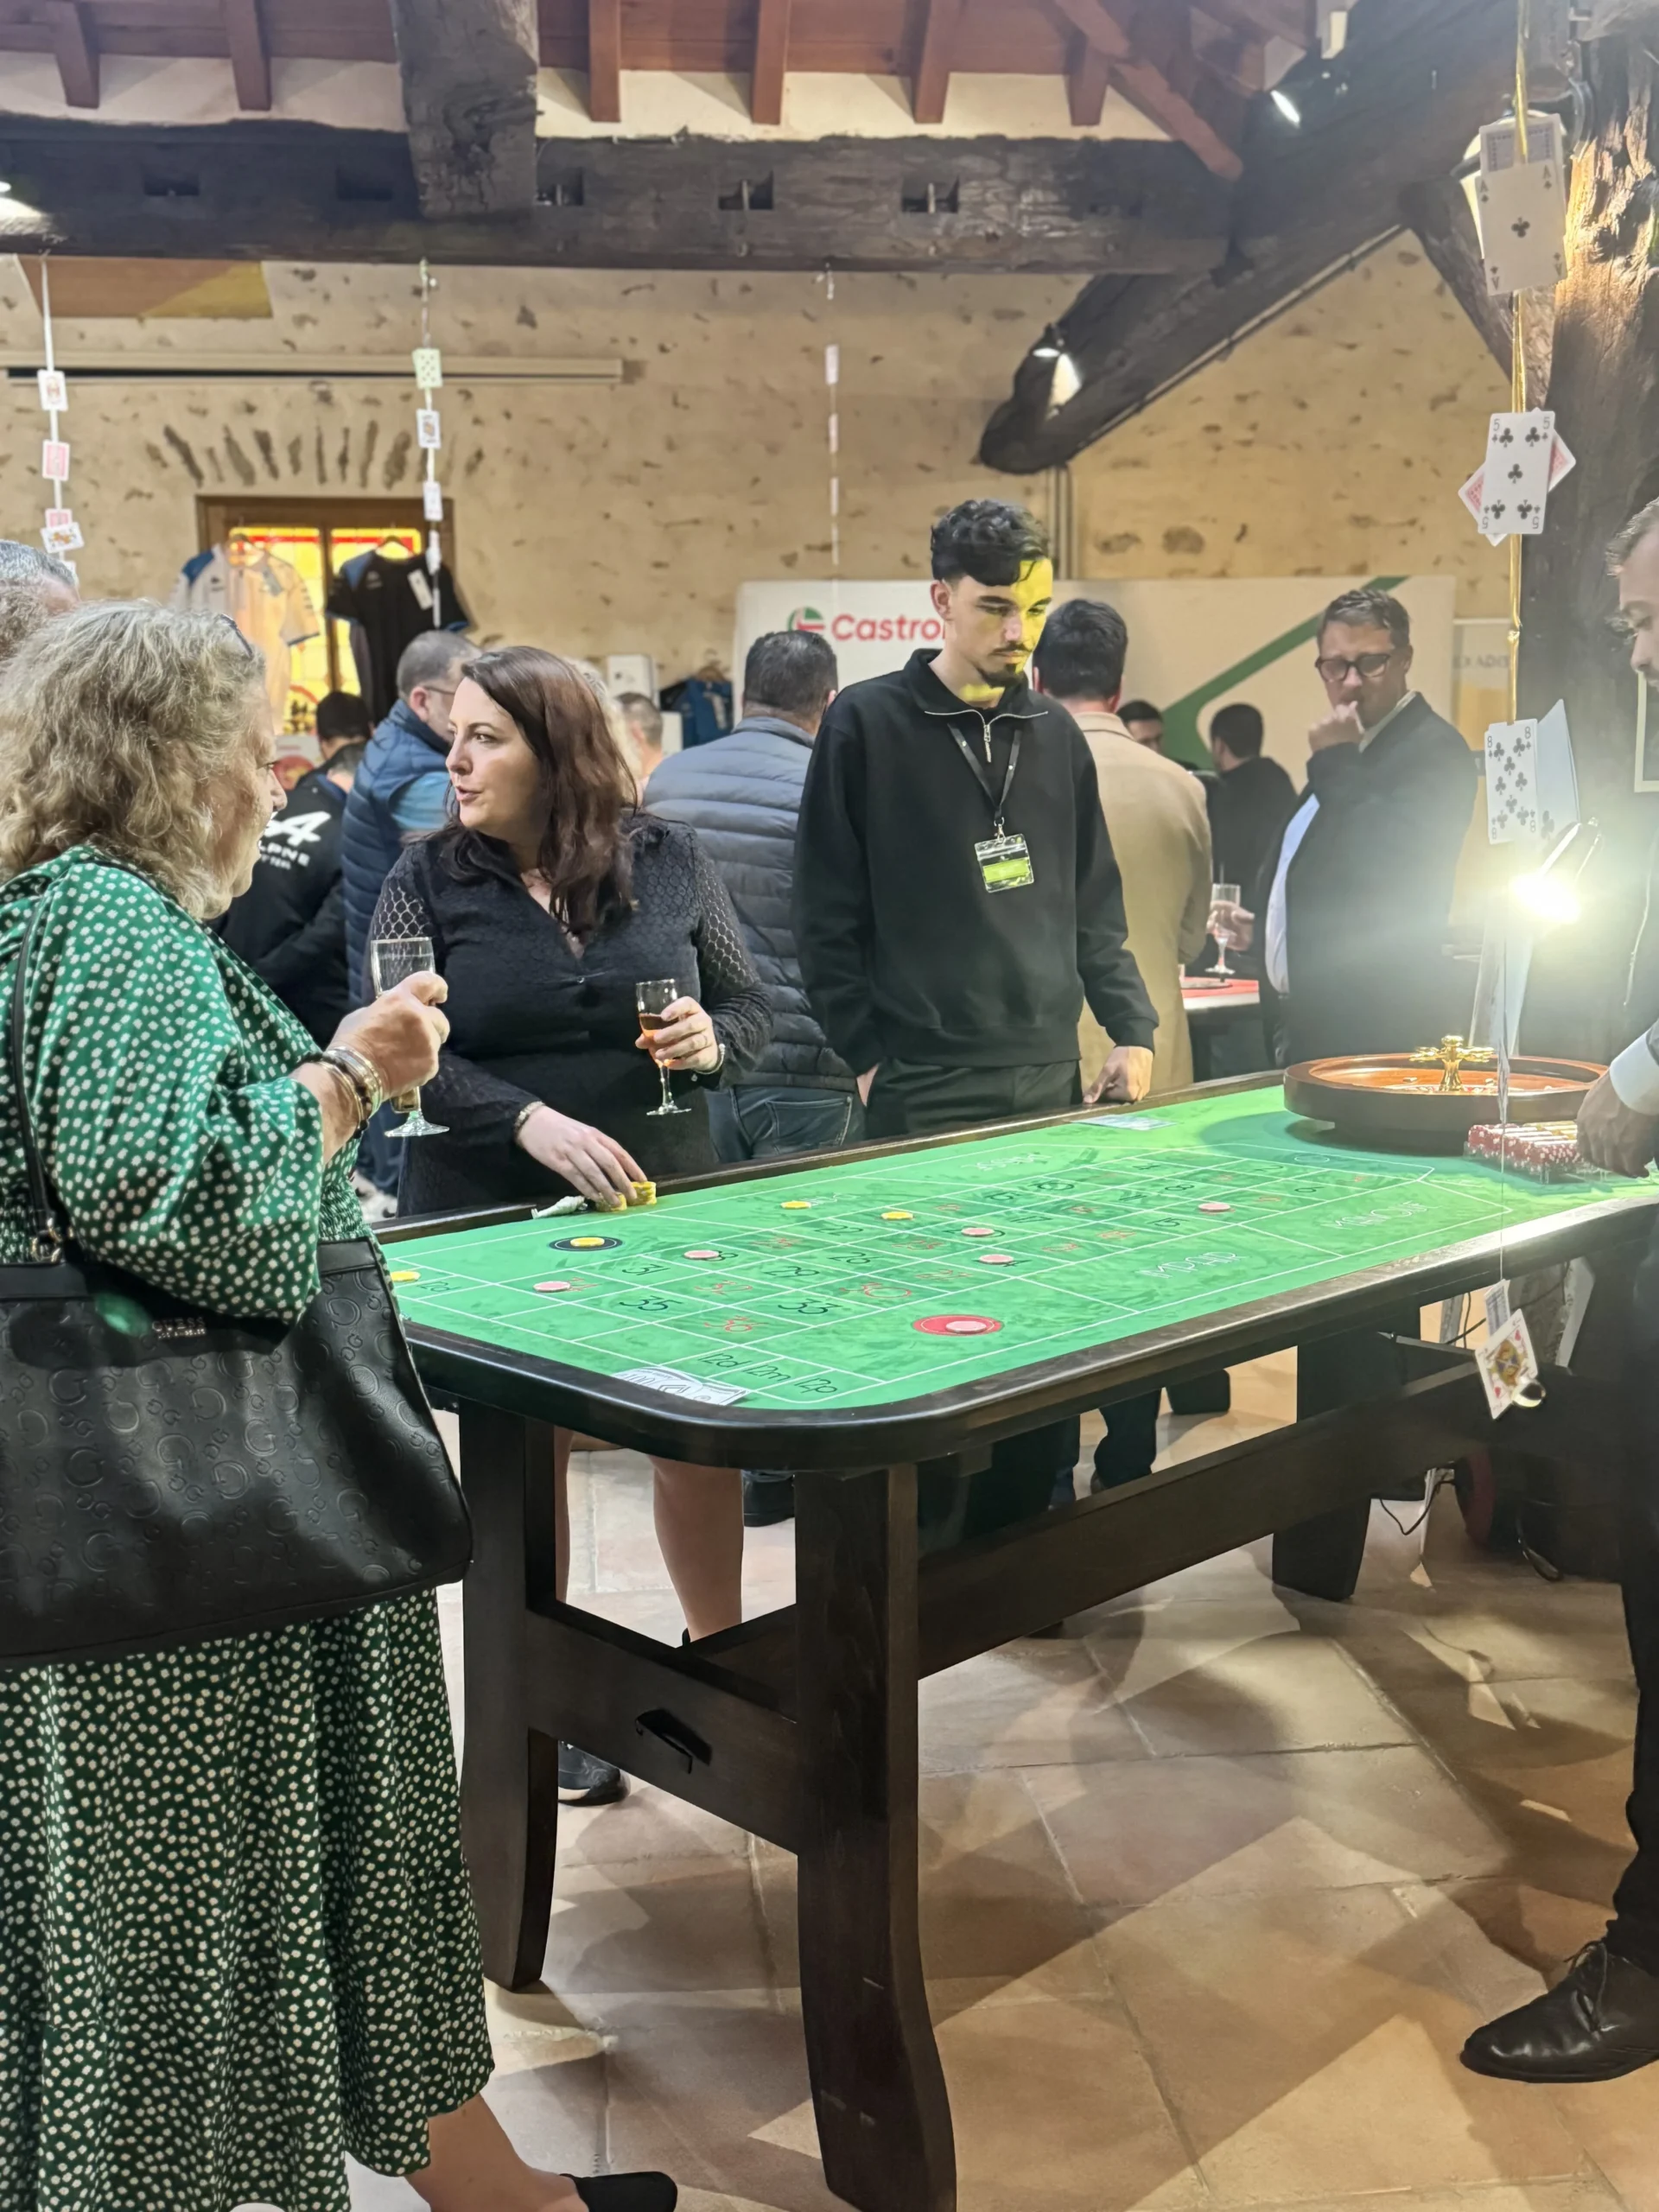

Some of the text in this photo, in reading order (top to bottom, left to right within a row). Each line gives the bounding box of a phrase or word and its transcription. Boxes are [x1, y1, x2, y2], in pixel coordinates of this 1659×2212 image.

[1479, 180, 1489, 192] A
[1493, 418, 1501, 431] 5
[1542, 416, 1551, 430] 5
[1482, 516, 1489, 530] 5
[1532, 516, 1540, 530] 5
[831, 613, 945, 641] Castro
[1524, 727, 1532, 740] 8
[1487, 735, 1494, 748] 8
[814, 1224, 864, 1236] 22
[826, 1251, 884, 1264] 26
[621, 1263, 671, 1276] 31
[761, 1265, 820, 1279] 29
[839, 1281, 912, 1299] 30
[619, 1294, 684, 1312] 35
[778, 1298, 842, 1315] 33
[702, 1314, 771, 1332] 36
[698, 1351, 752, 1369] 12d
[741, 1363, 792, 1382] 12m
[791, 1376, 839, 1394] 12p
